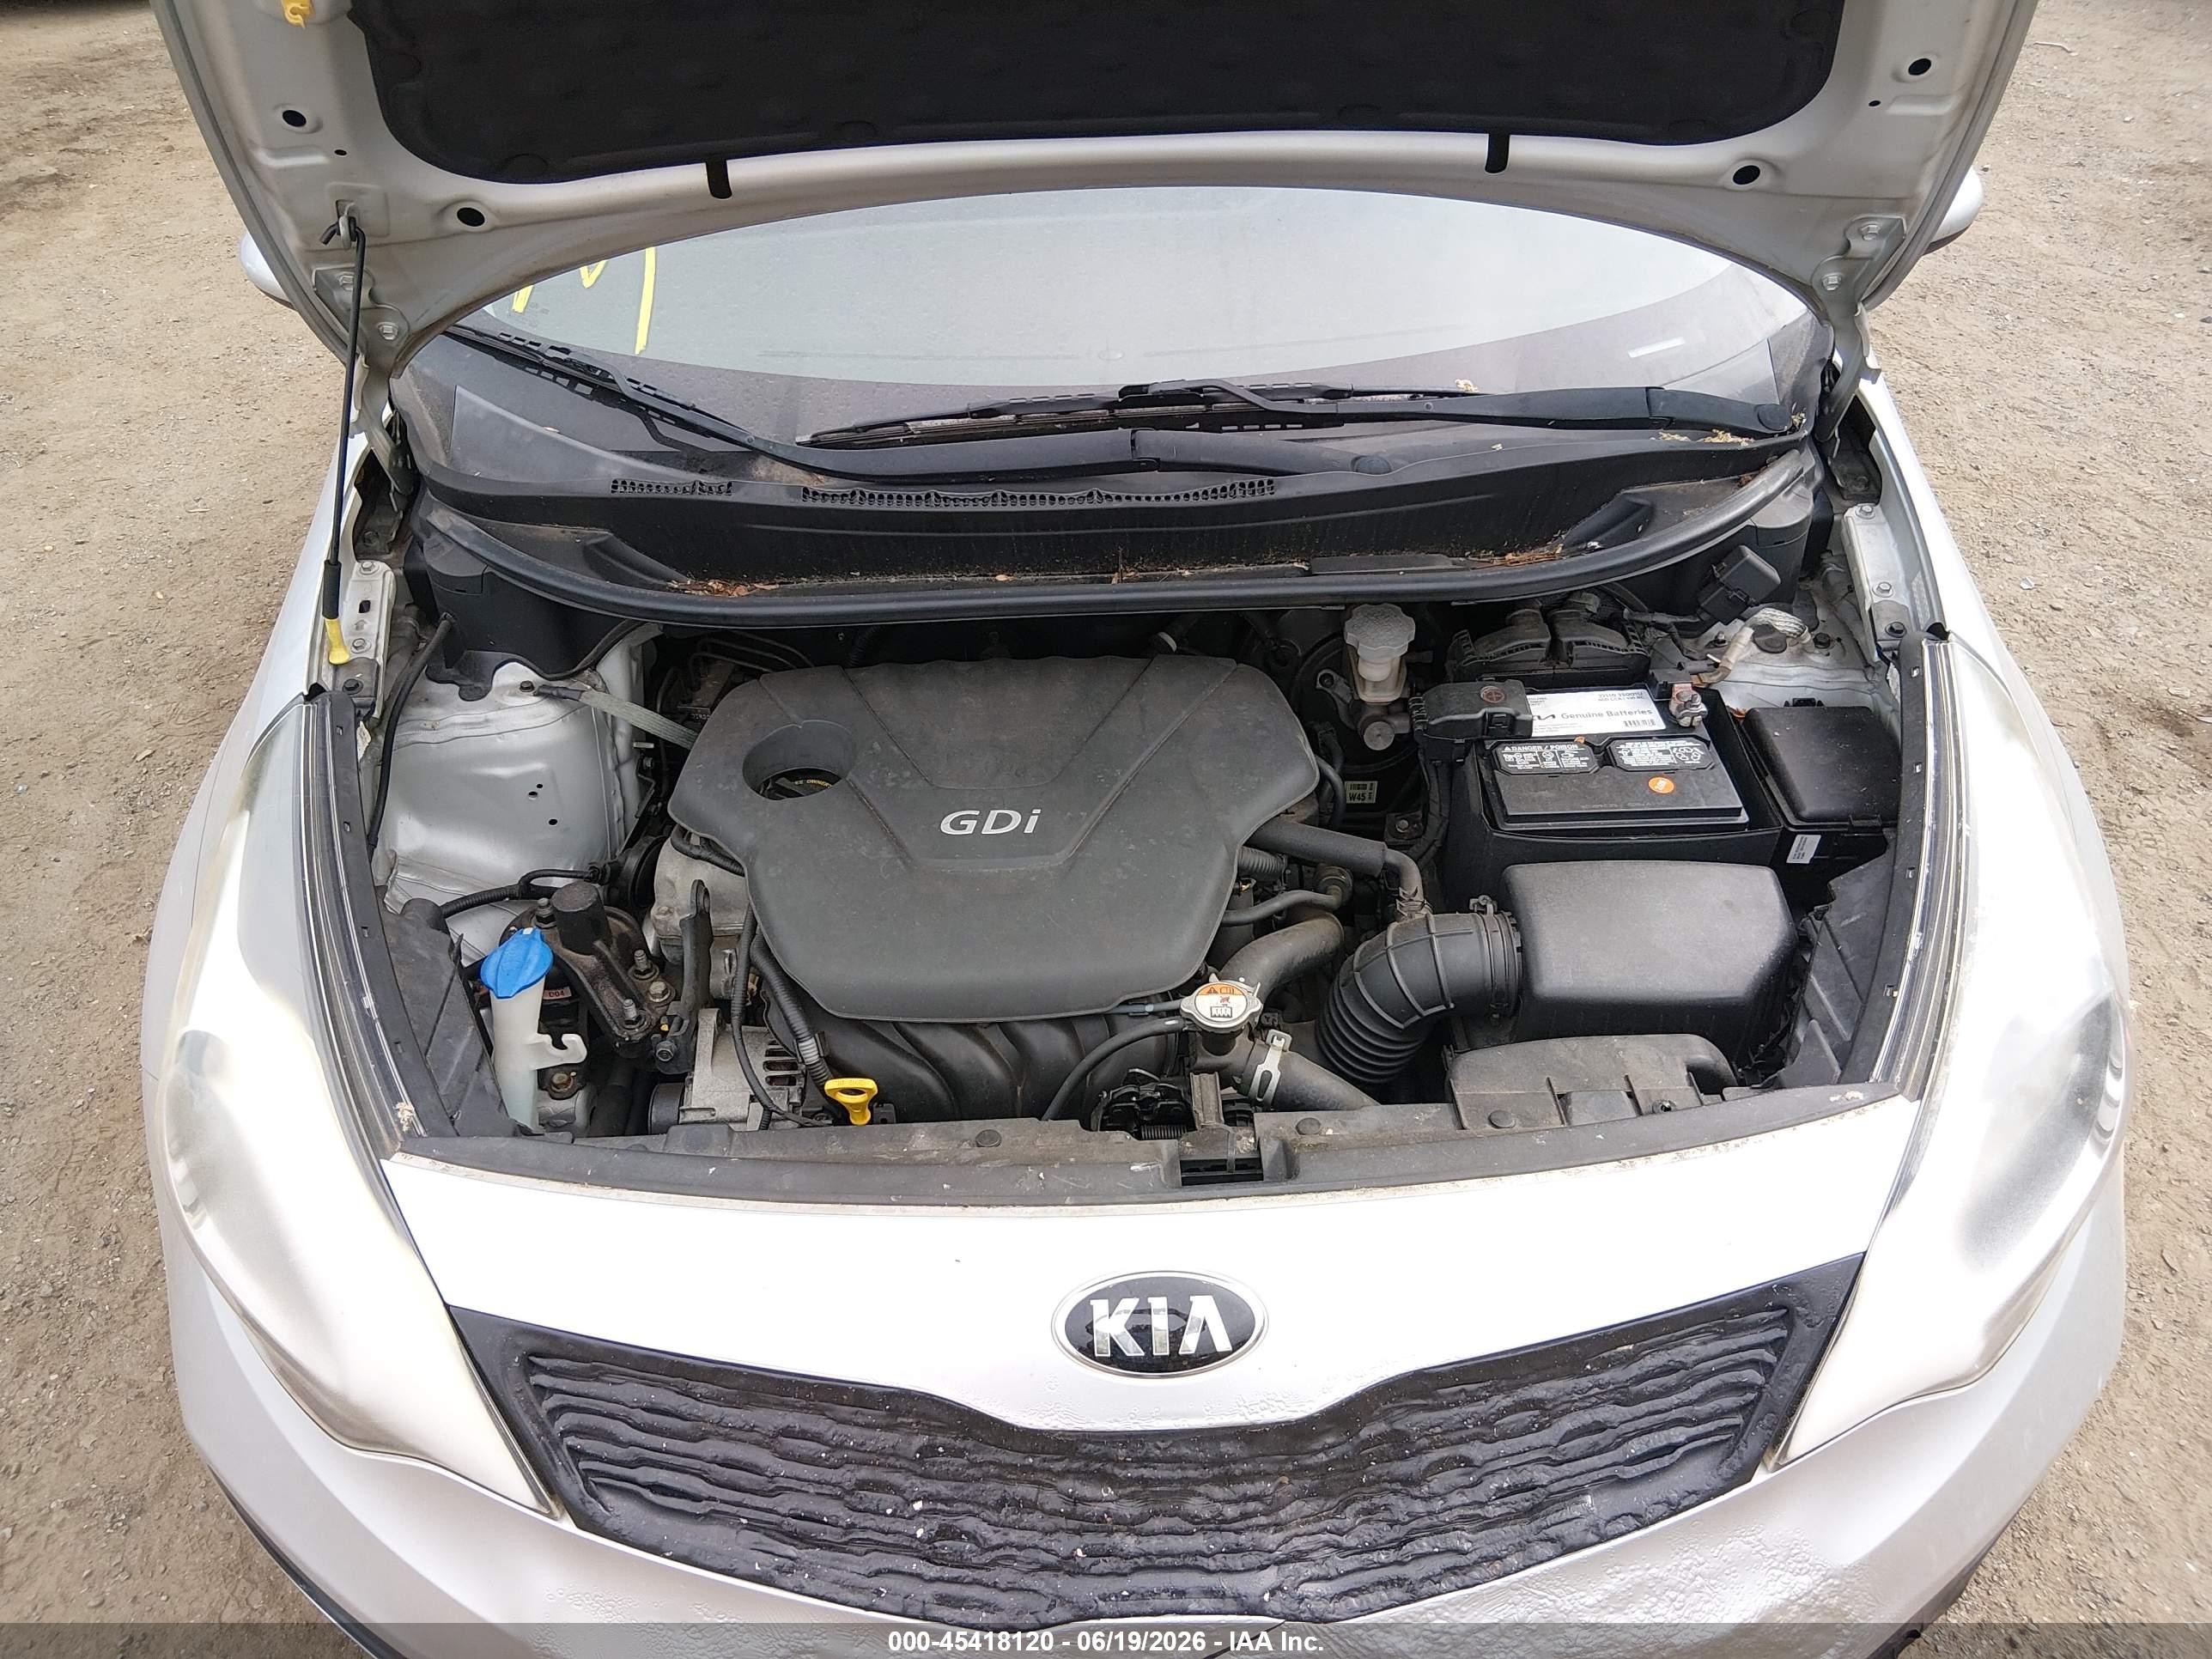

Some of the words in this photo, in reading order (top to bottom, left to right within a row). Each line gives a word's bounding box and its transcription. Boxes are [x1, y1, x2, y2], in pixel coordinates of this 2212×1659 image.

[1606, 708, 1653, 718] Batteries
[1348, 793, 1366, 802] W45
[940, 809, 1042, 836] GDi
[1090, 1295, 1233, 1357] KIA
